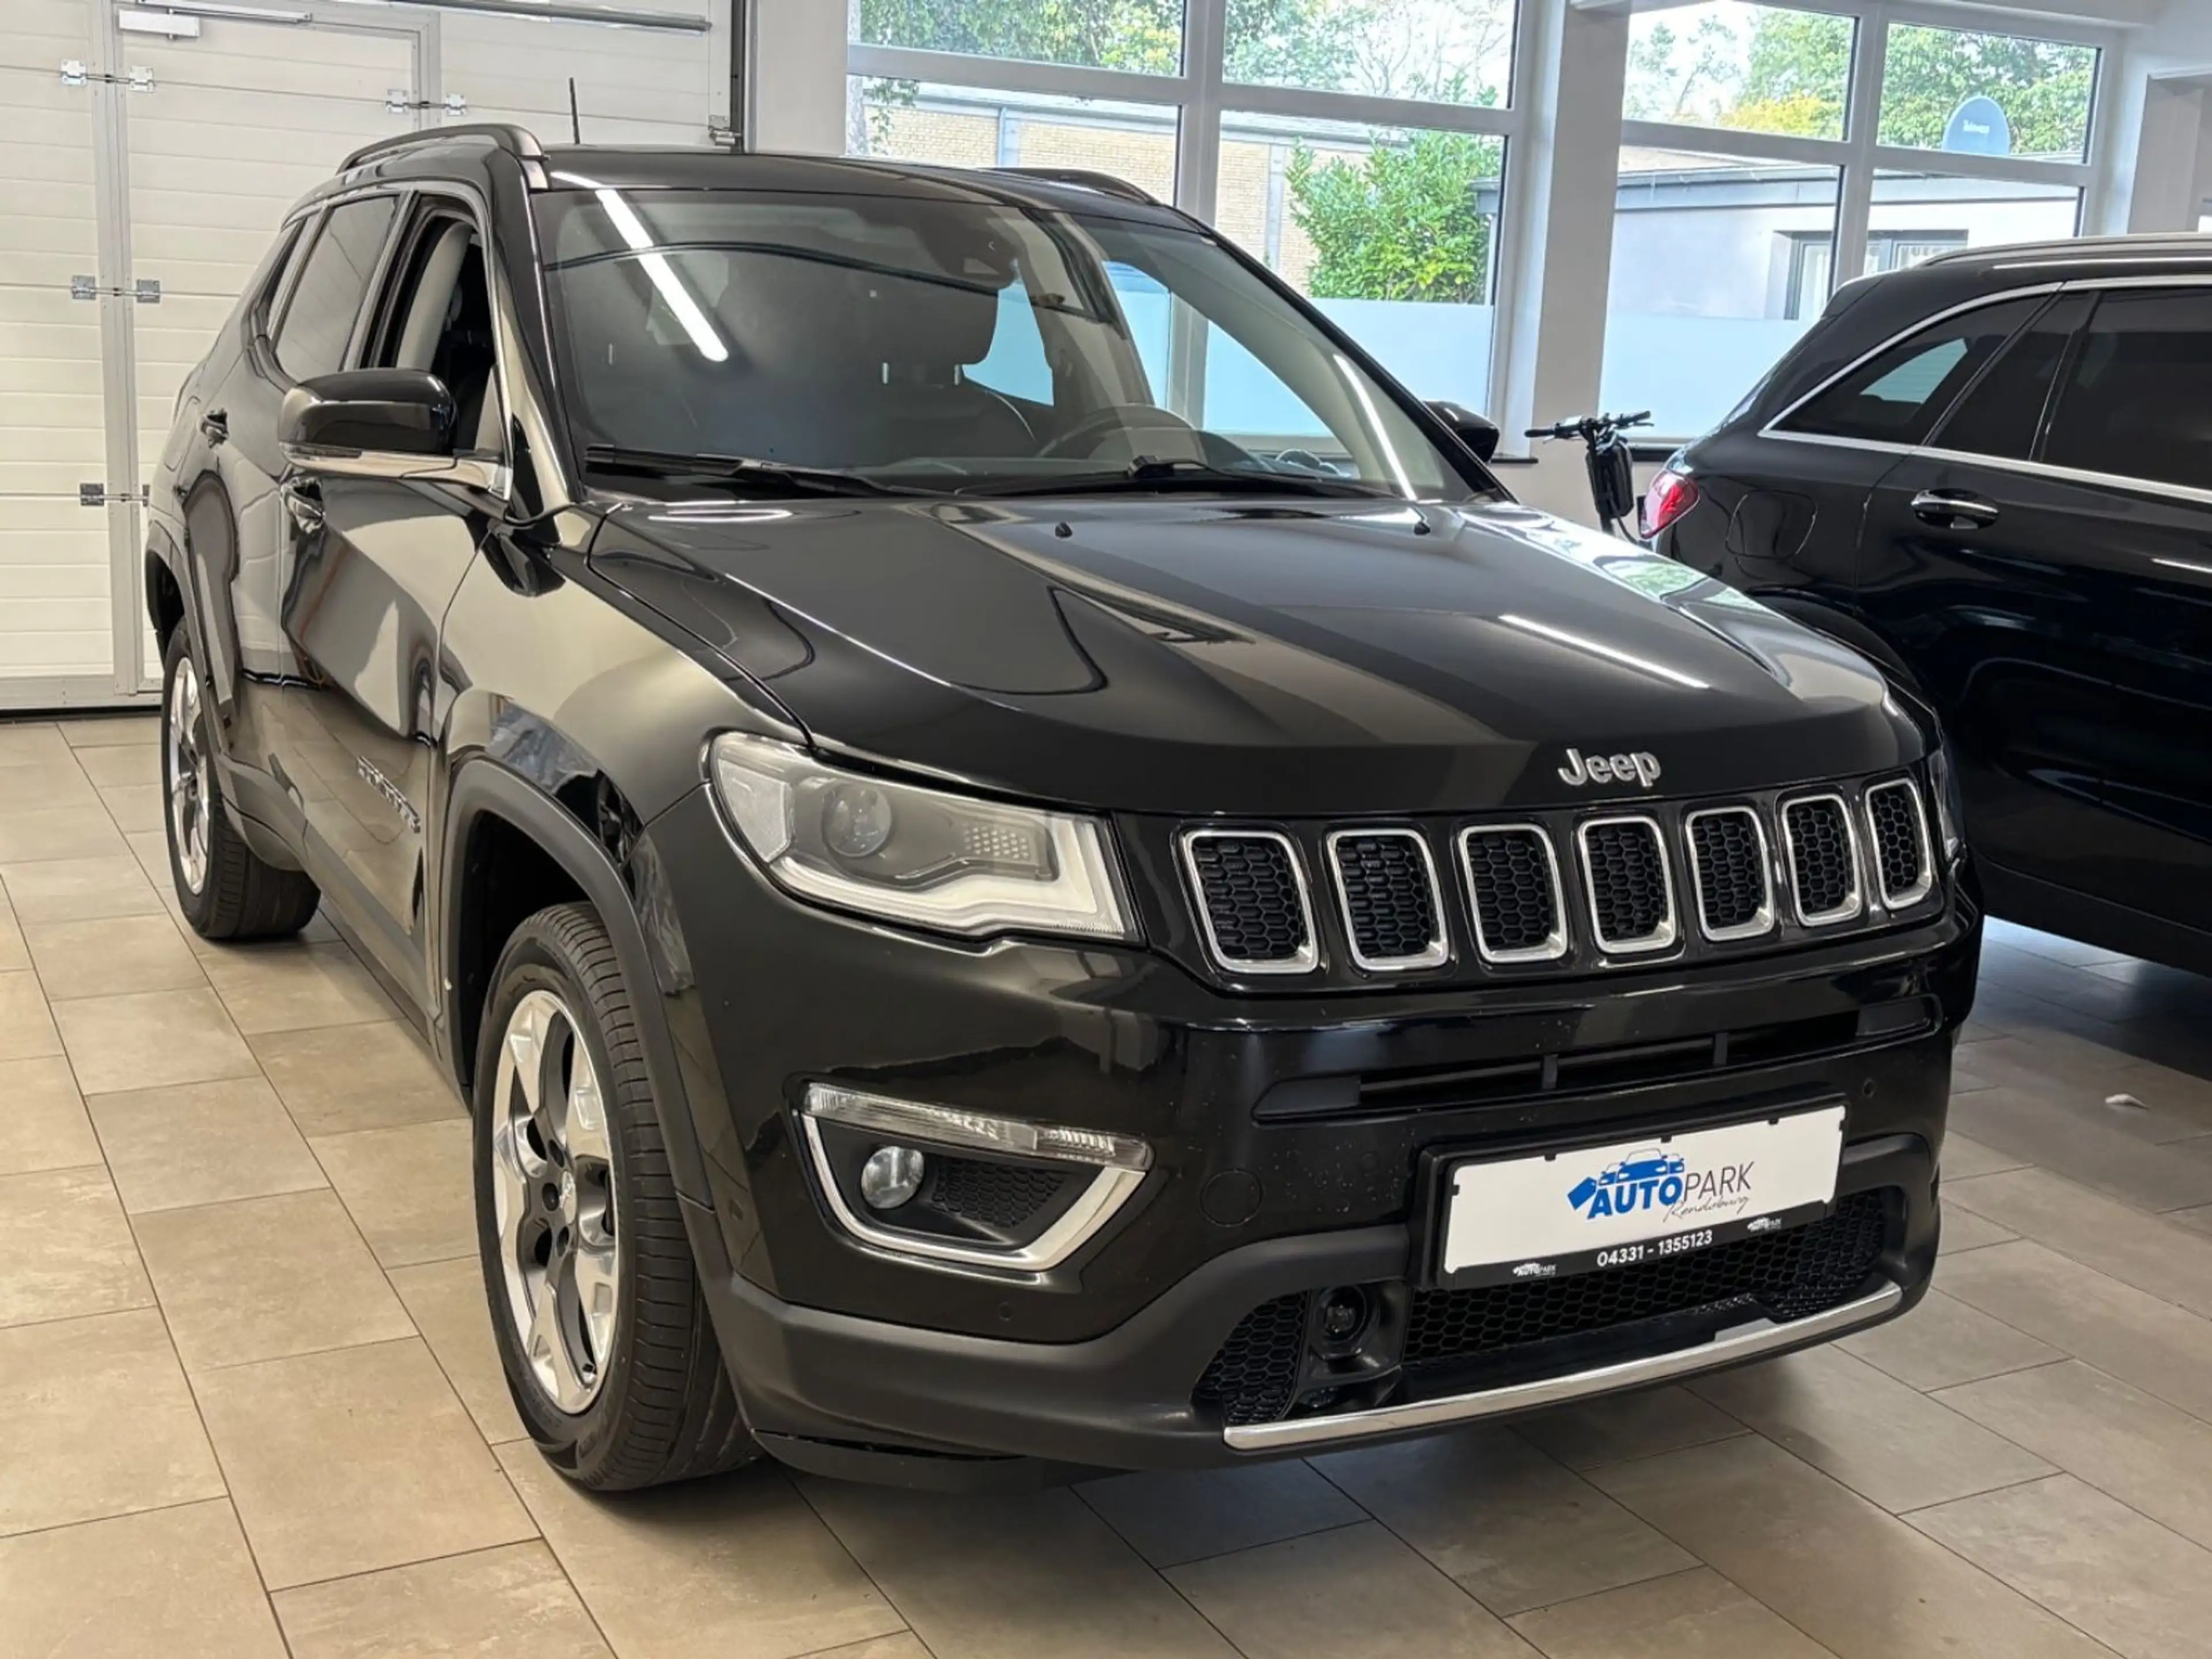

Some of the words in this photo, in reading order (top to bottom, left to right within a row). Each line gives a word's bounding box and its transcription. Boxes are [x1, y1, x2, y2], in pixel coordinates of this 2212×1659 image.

[1557, 748, 1661, 787] Jeep
[1596, 1245, 1644, 1267] 04331
[1658, 1229, 1713, 1255] 1355123
